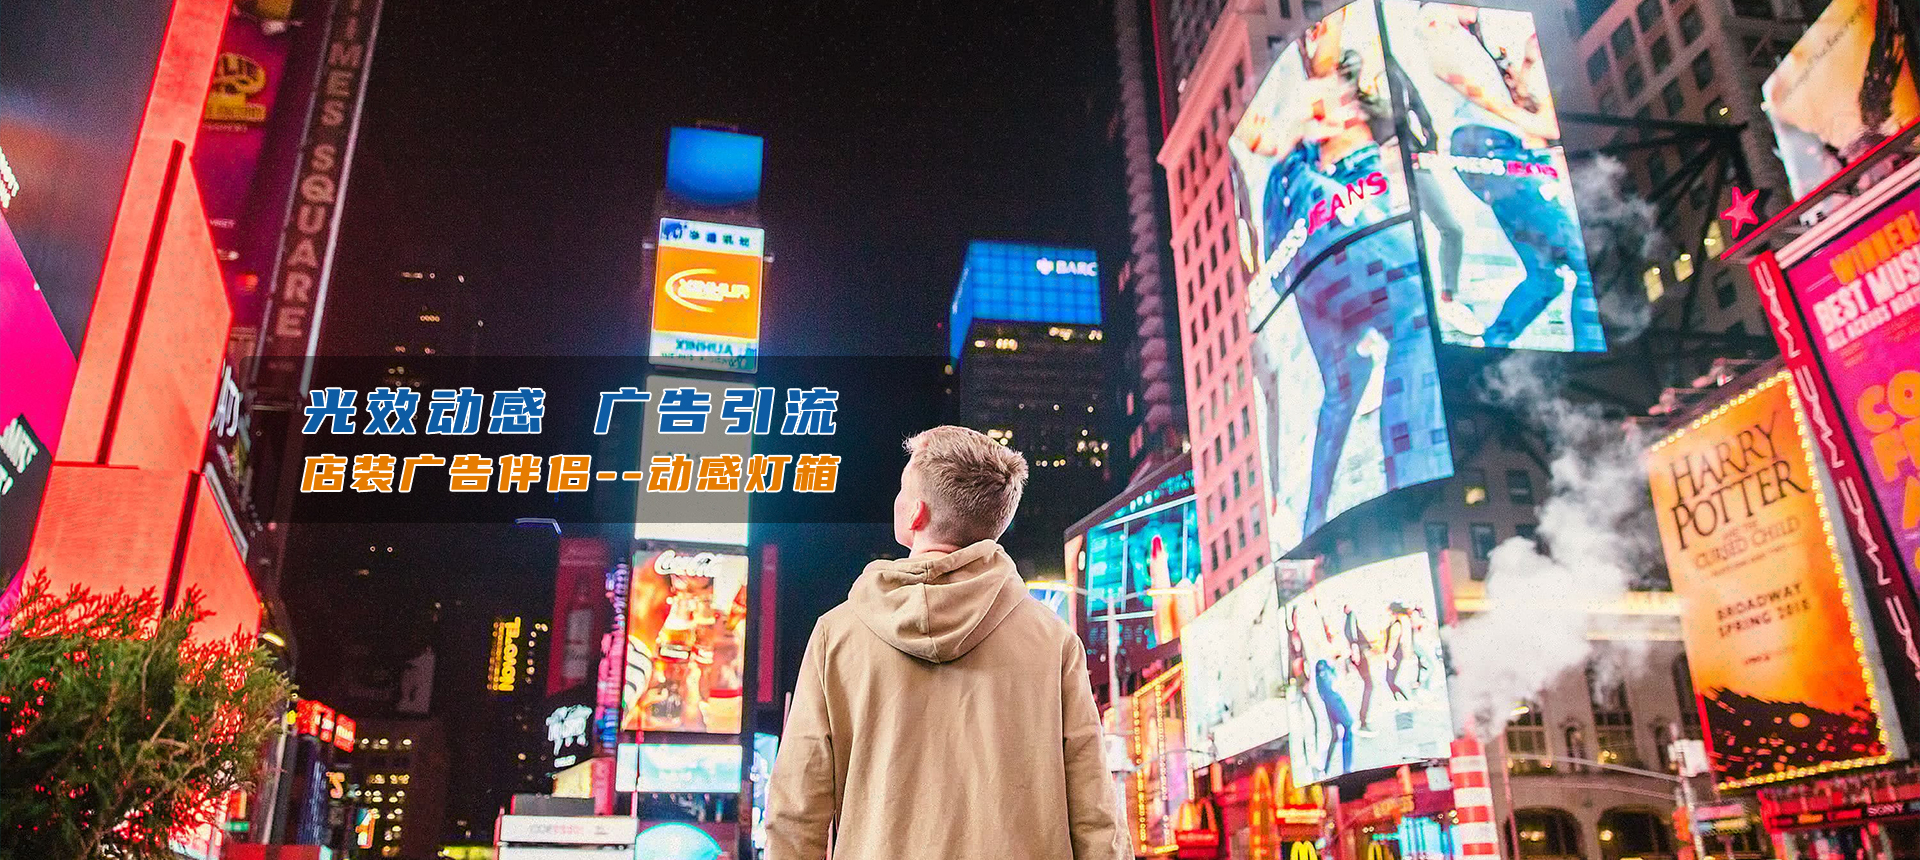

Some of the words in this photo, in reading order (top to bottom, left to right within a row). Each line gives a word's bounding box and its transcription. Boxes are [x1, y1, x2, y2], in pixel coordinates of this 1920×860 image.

[1307, 171, 1388, 236] JEANS
[276, 144, 337, 338] SQUARE
[1812, 278, 1870, 335] BEST
[1865, 243, 1920, 306] MUS
[675, 338, 733, 356] XINHUA
[1669, 411, 1778, 501] HARRY
[1671, 460, 1807, 550] POTTER
[1717, 582, 1802, 621] BROADWAY
[1718, 611, 1772, 638] SPRING
[1866, 802, 1904, 817] SONY
